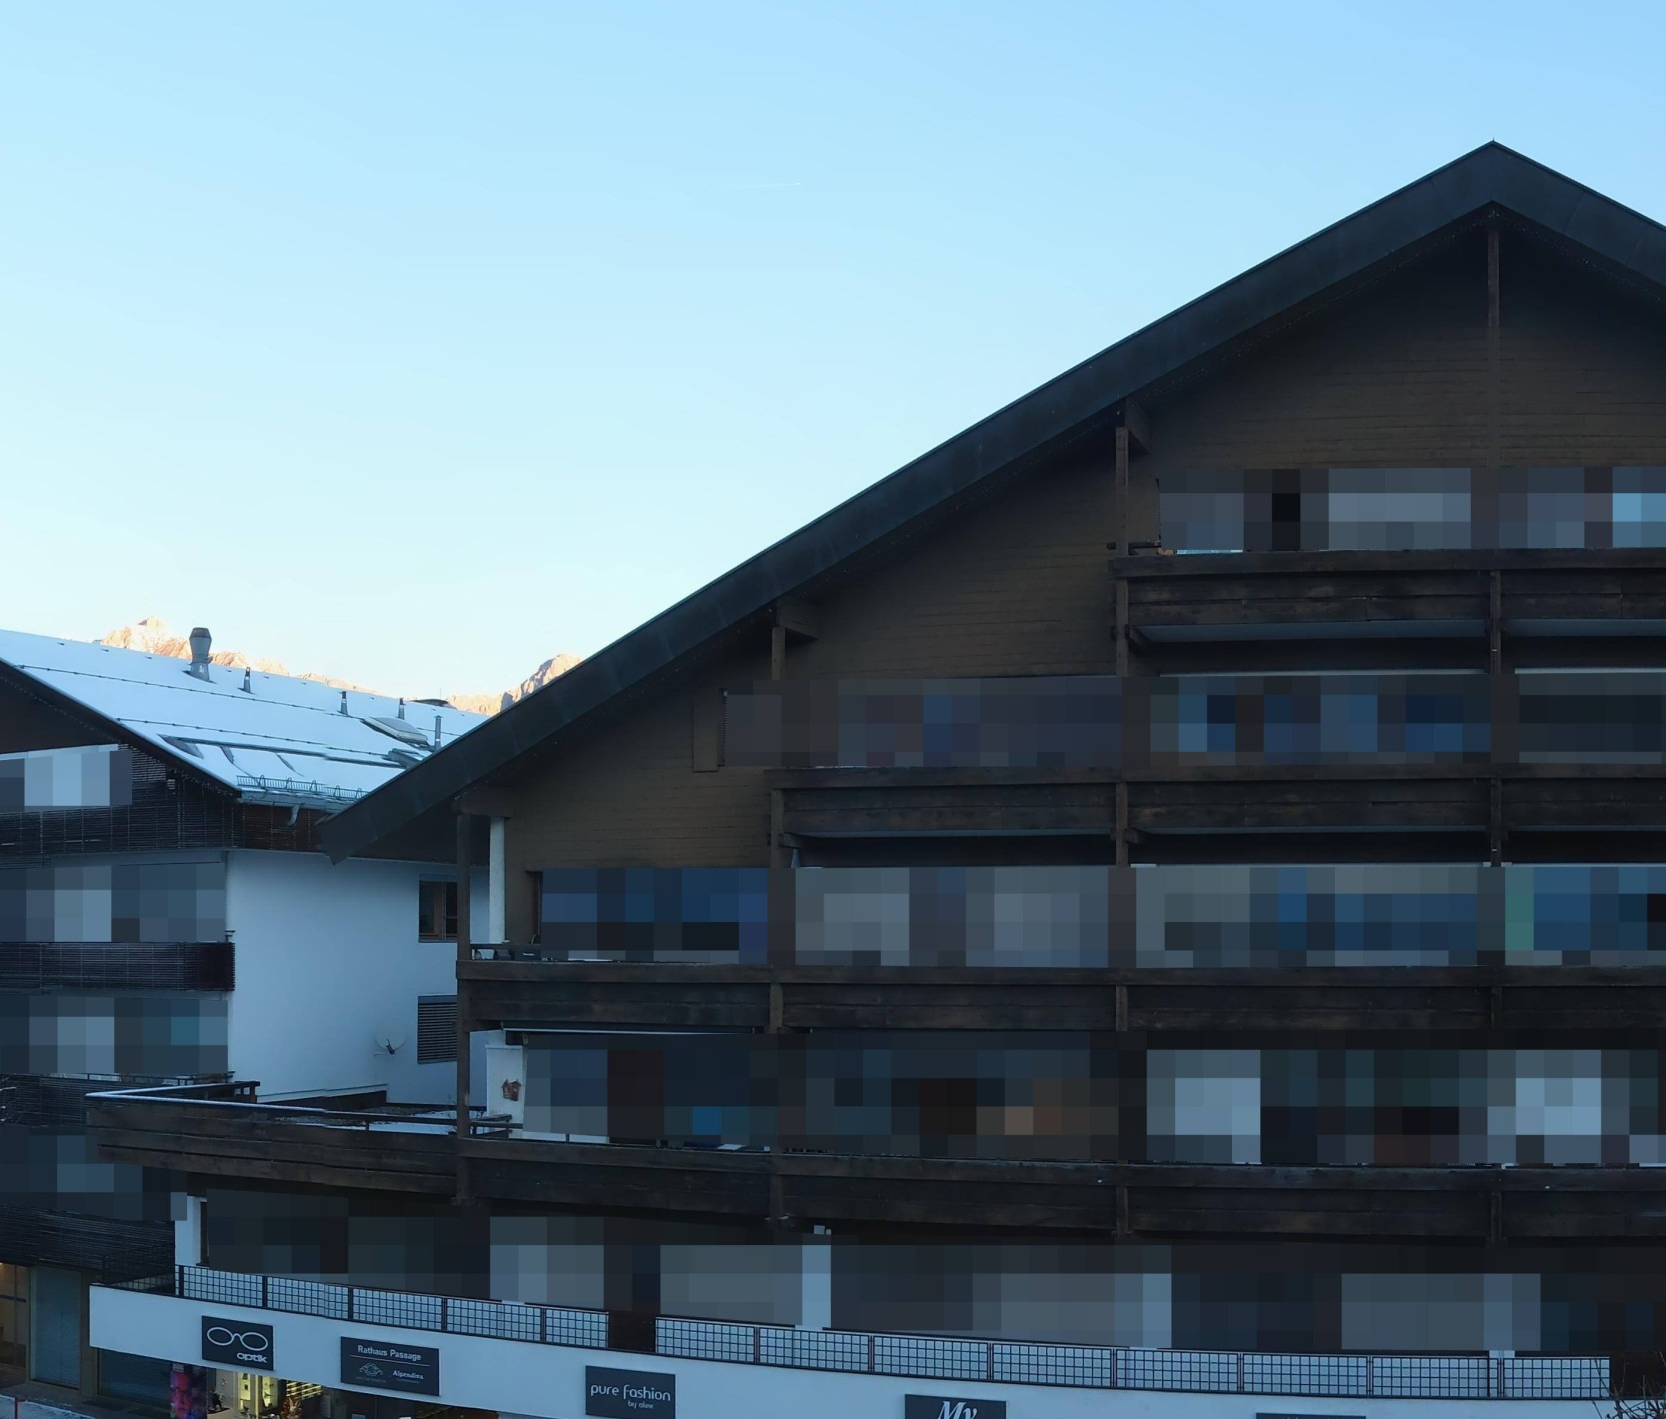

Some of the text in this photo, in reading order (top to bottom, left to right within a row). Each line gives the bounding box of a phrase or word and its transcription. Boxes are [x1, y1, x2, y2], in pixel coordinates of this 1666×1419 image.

[357, 1344, 422, 1362] Rathaus Passage
[590, 1384, 671, 1402] pure fashion
